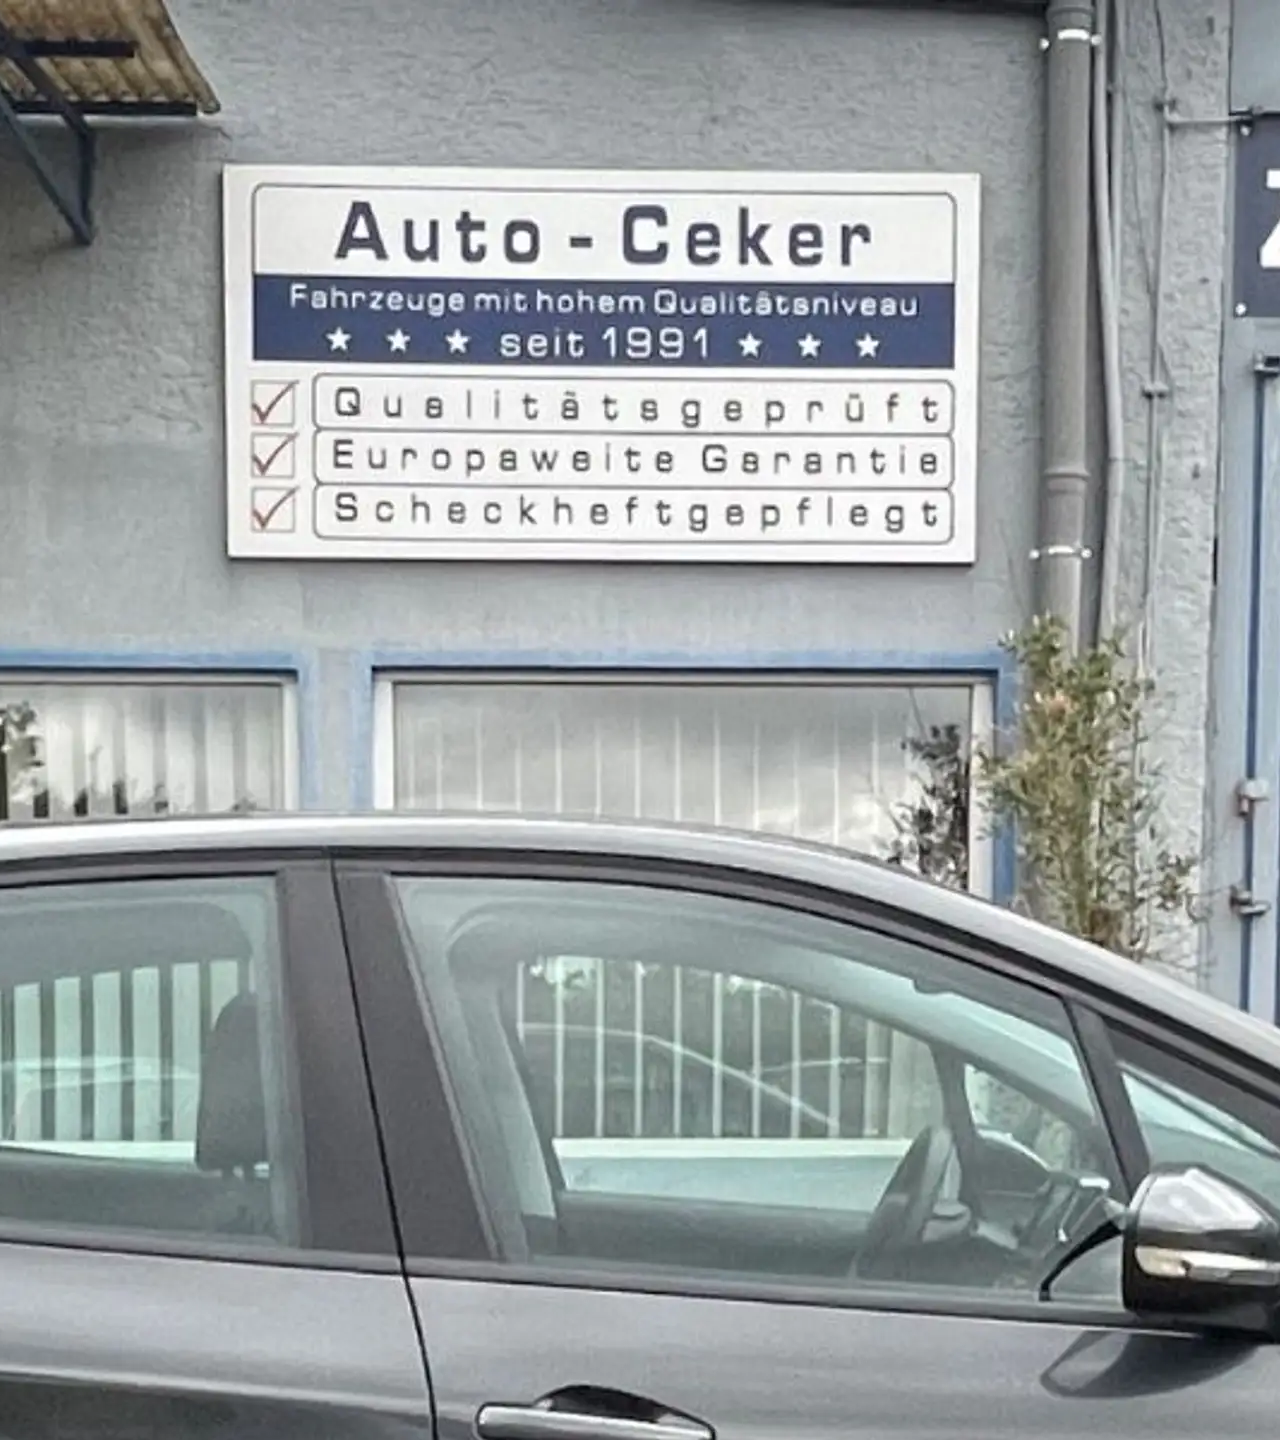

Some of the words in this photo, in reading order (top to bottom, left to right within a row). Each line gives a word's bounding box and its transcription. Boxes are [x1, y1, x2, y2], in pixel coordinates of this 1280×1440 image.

[334, 200, 542, 264] Auto
[621, 205, 872, 268] Ceker
[290, 284, 465, 315] Fahrzeuge
[474, 289, 529, 313] mit
[536, 290, 645, 314] hohem
[654, 289, 917, 320] Qualitätsniveau
[500, 331, 584, 357] seit
[602, 328, 710, 358] 1991
[334, 386, 940, 426] Qualitätsgeprüft
[333, 440, 674, 476] Europaweite
[702, 444, 939, 476] Garantie
[334, 494, 939, 532] Scheckheftgepflegt
